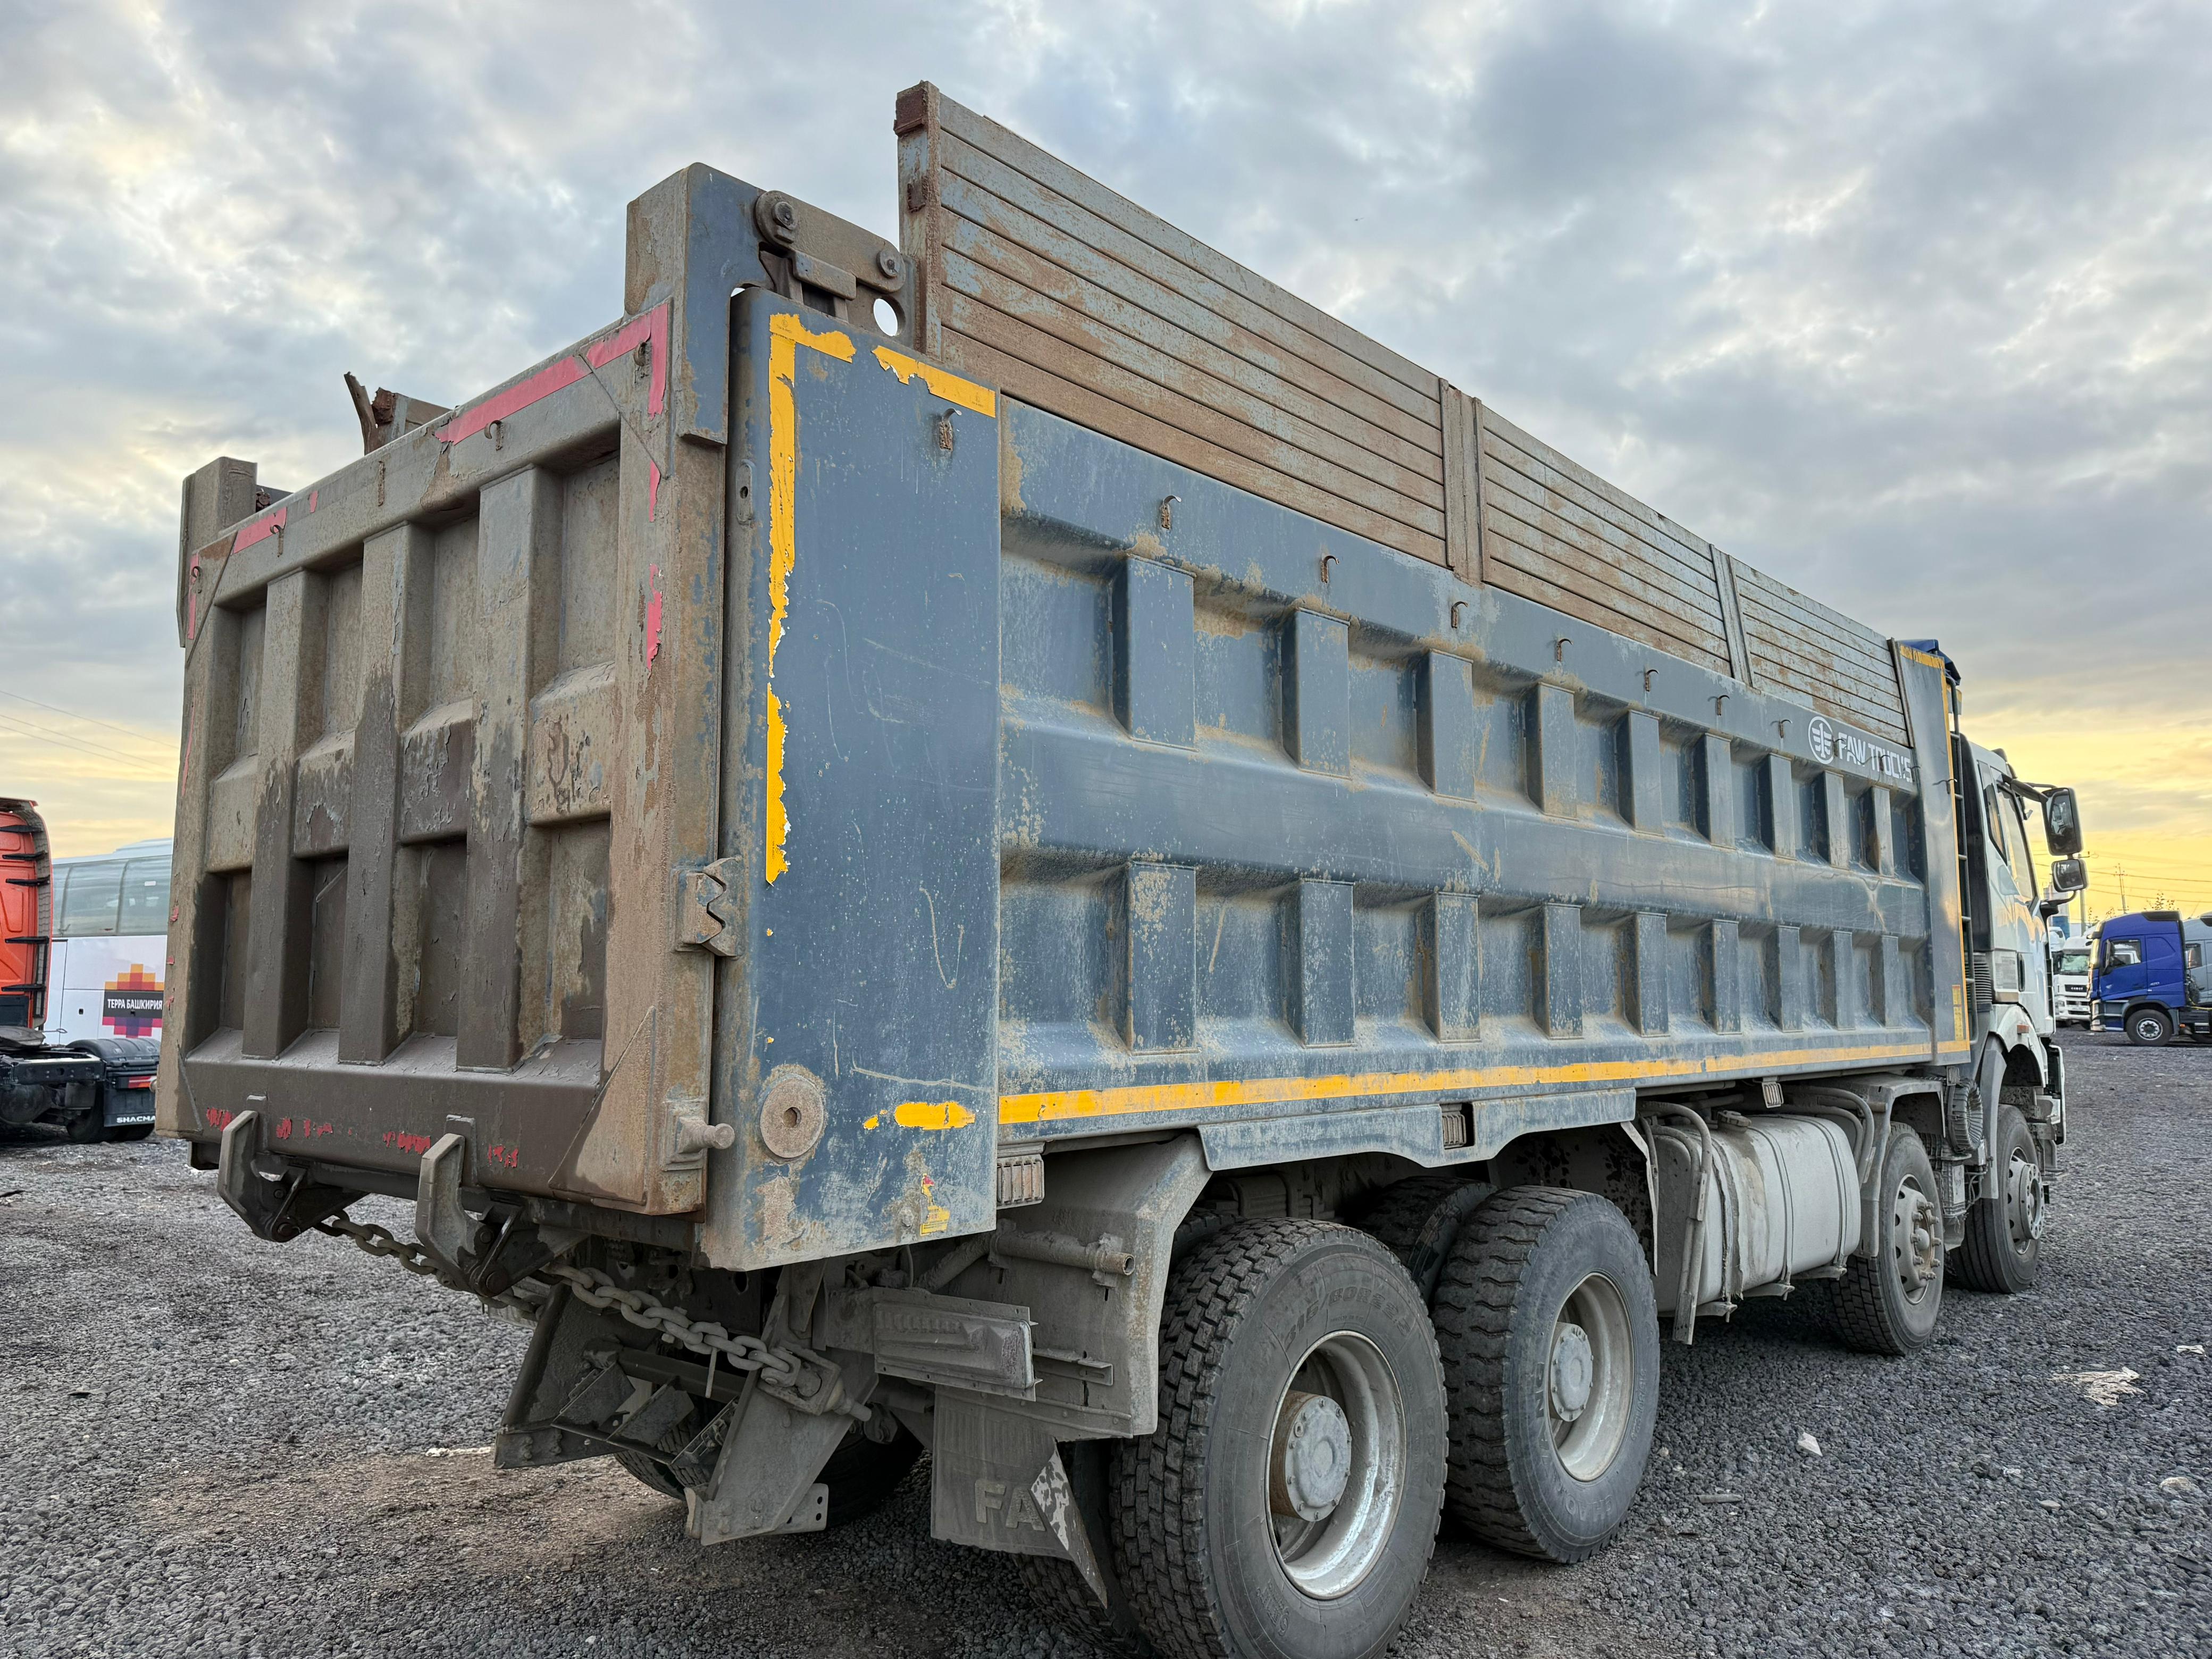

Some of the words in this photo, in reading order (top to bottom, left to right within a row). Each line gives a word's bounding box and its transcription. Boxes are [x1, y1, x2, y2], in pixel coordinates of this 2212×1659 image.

[1838, 732, 1866, 767] FAW
[107, 999, 125, 1009] ТЕРРА
[127, 999, 163, 1010] БАШКИРИЯ
[974, 1479, 1047, 1532] FA
